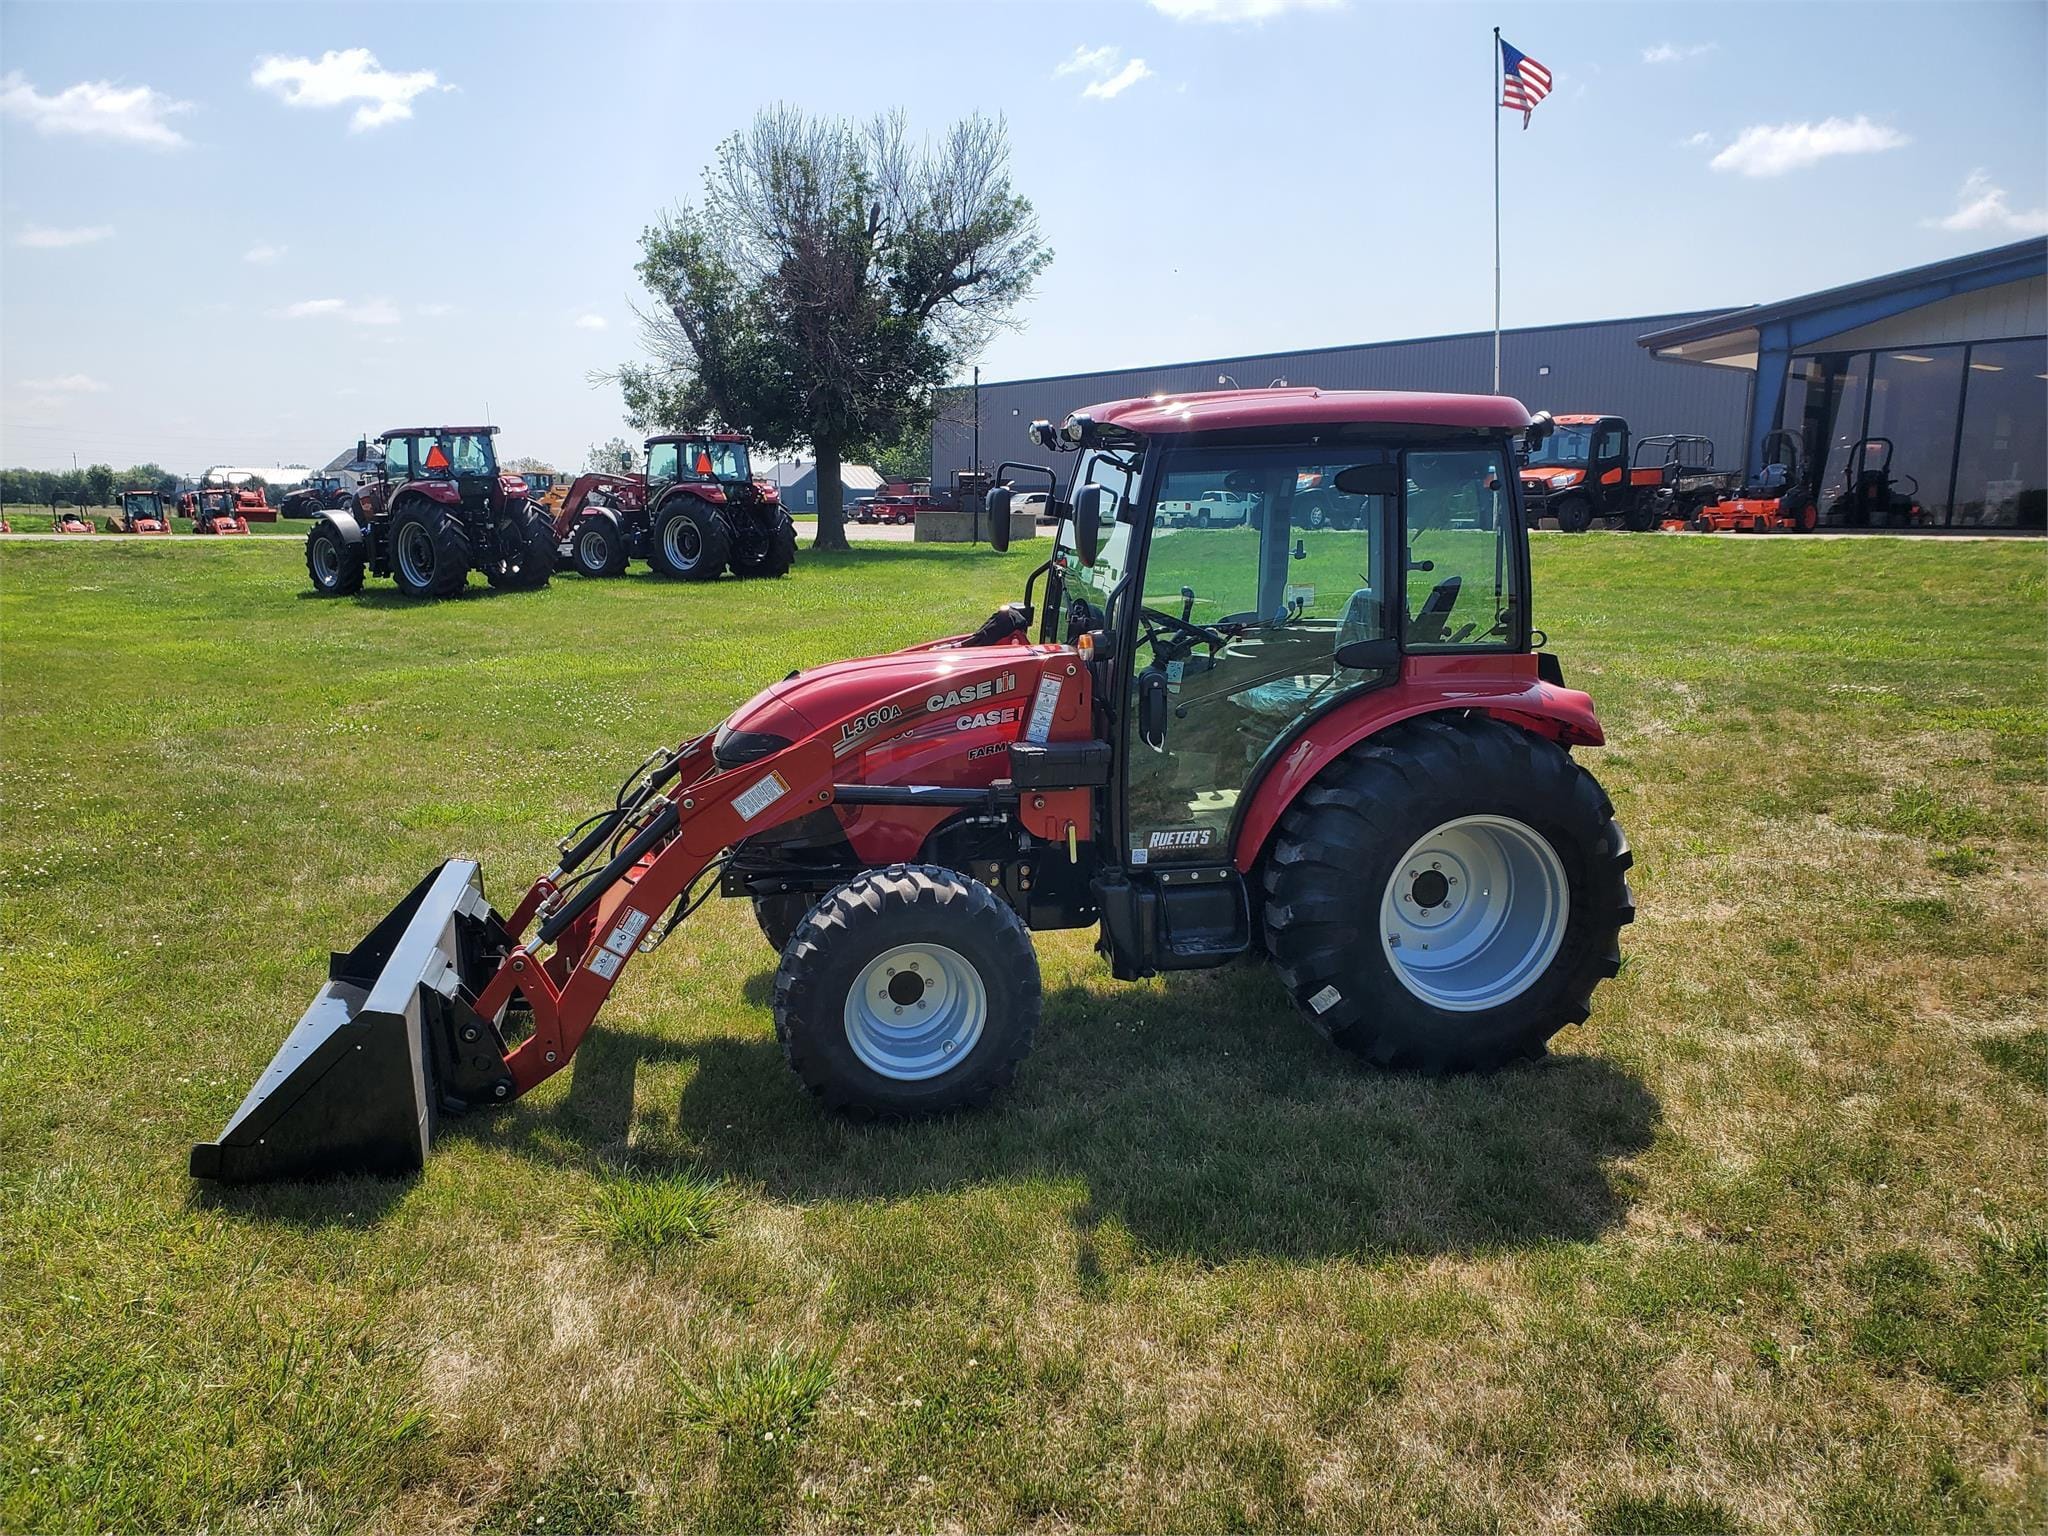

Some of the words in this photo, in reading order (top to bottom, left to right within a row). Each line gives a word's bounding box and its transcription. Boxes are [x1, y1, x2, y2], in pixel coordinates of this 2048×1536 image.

[926, 681, 992, 712] CASE
[841, 704, 903, 741] L360A
[956, 708, 1015, 731] CASE
[967, 742, 1008, 761] FARM
[1149, 830, 1211, 849] RUETER'S
